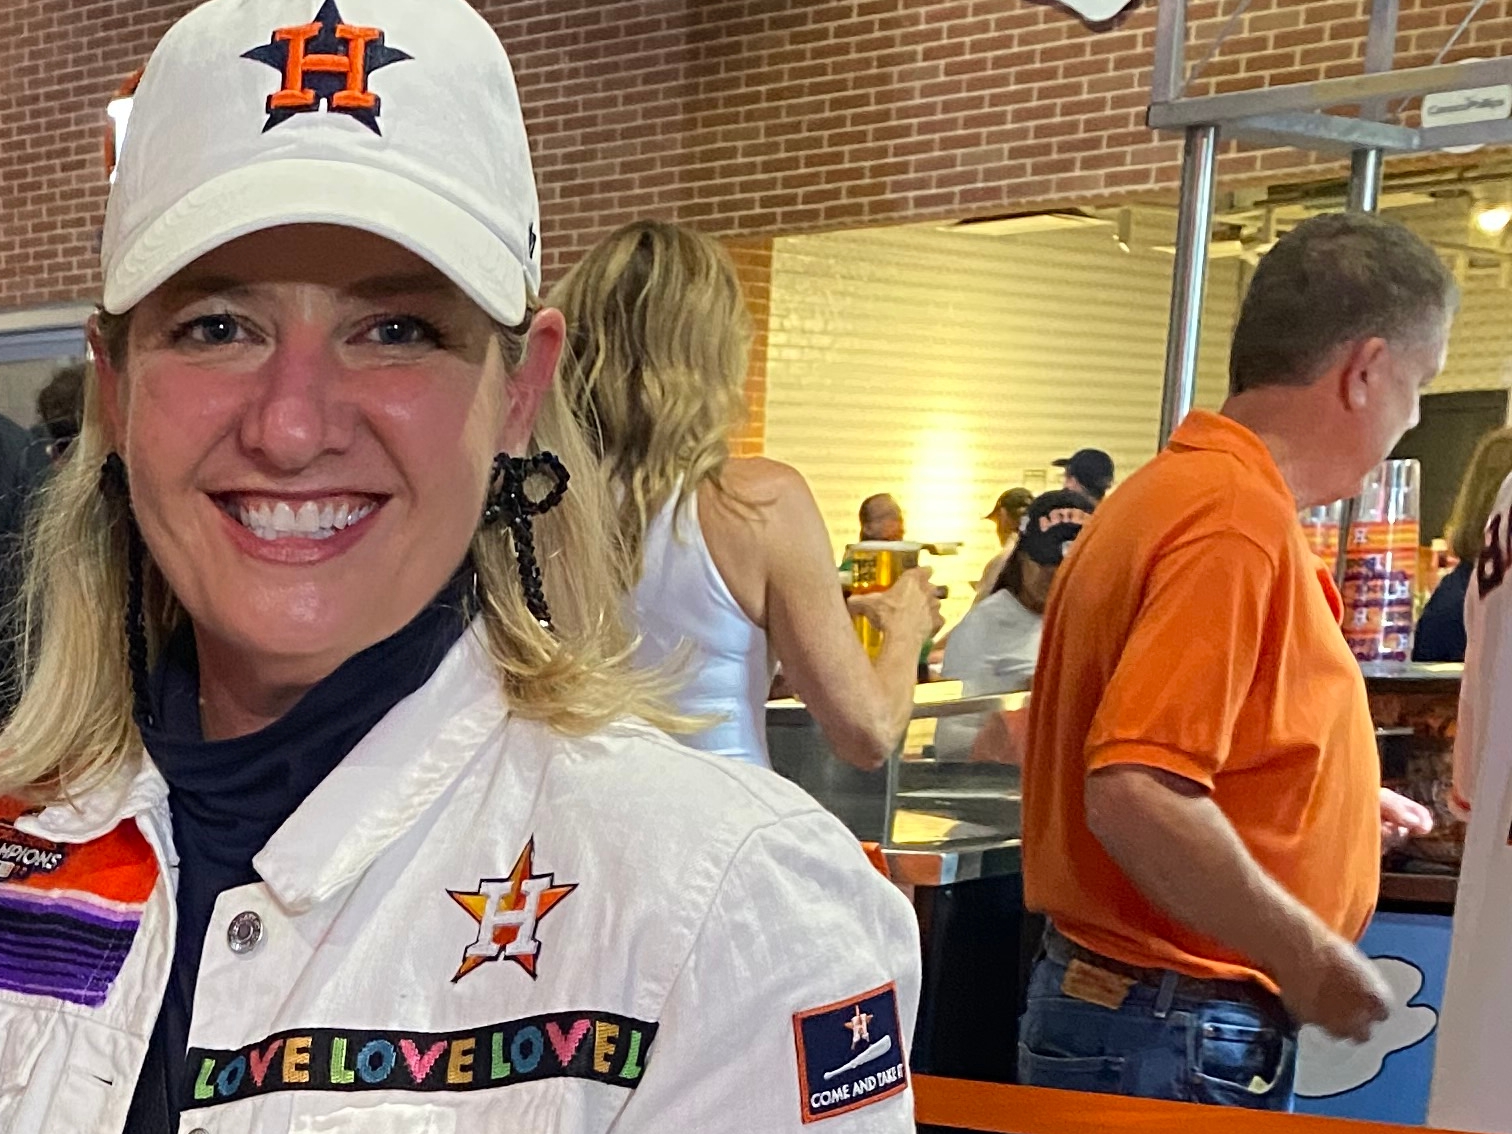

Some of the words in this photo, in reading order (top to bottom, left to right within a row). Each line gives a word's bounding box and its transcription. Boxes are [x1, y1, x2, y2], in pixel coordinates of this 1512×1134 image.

[270, 22, 380, 109] H
[465, 878, 552, 958] H
[194, 1036, 312, 1099] LOVE
[330, 1037, 476, 1084] LOVE
[491, 1019, 620, 1080] LOVE
[811, 1083, 850, 1108] COME
[852, 1075, 877, 1097] AND
[877, 1065, 897, 1086] TAKE
